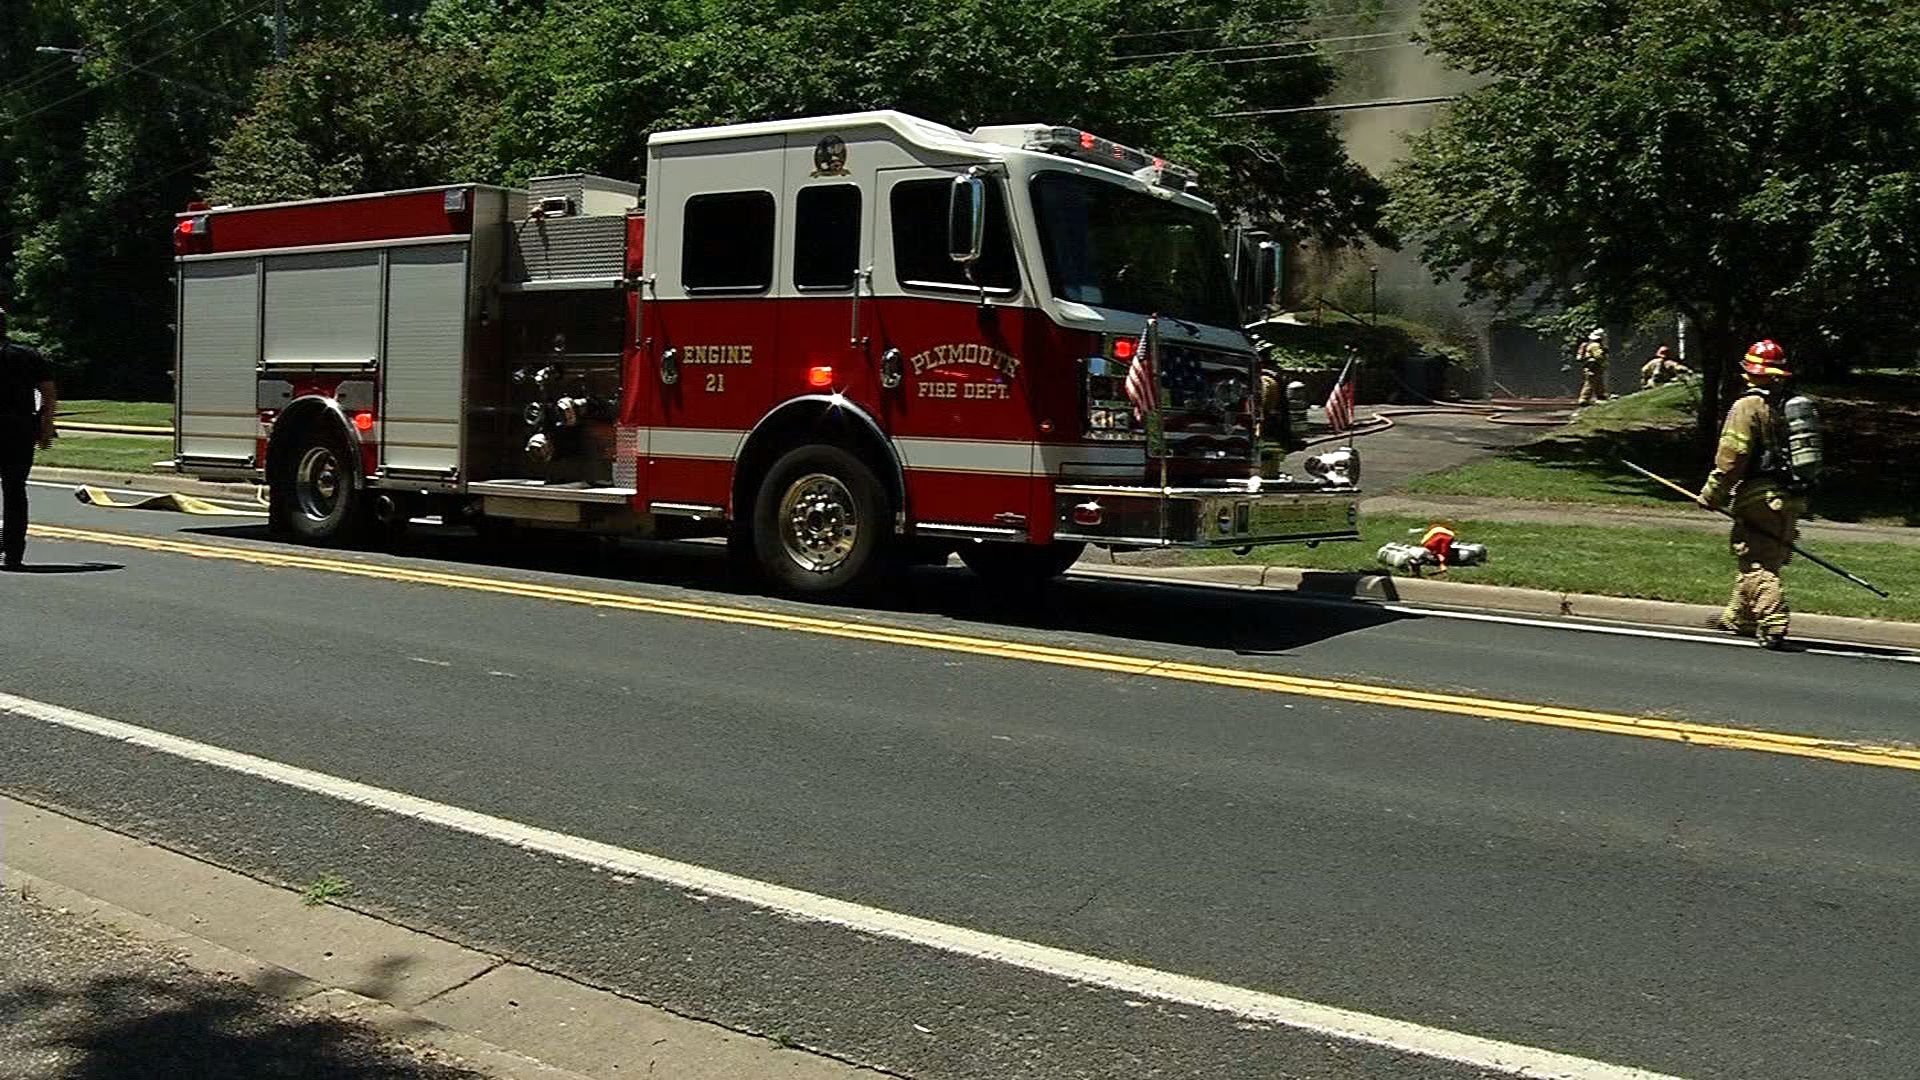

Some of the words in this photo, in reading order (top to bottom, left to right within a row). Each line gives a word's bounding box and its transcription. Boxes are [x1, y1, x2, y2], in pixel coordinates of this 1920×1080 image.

[683, 345, 753, 365] ENGINE
[910, 343, 1021, 378] PLYMOUTH
[705, 373, 725, 392] 21
[918, 382, 960, 399] FIRE
[963, 382, 1011, 399] DEPT.
